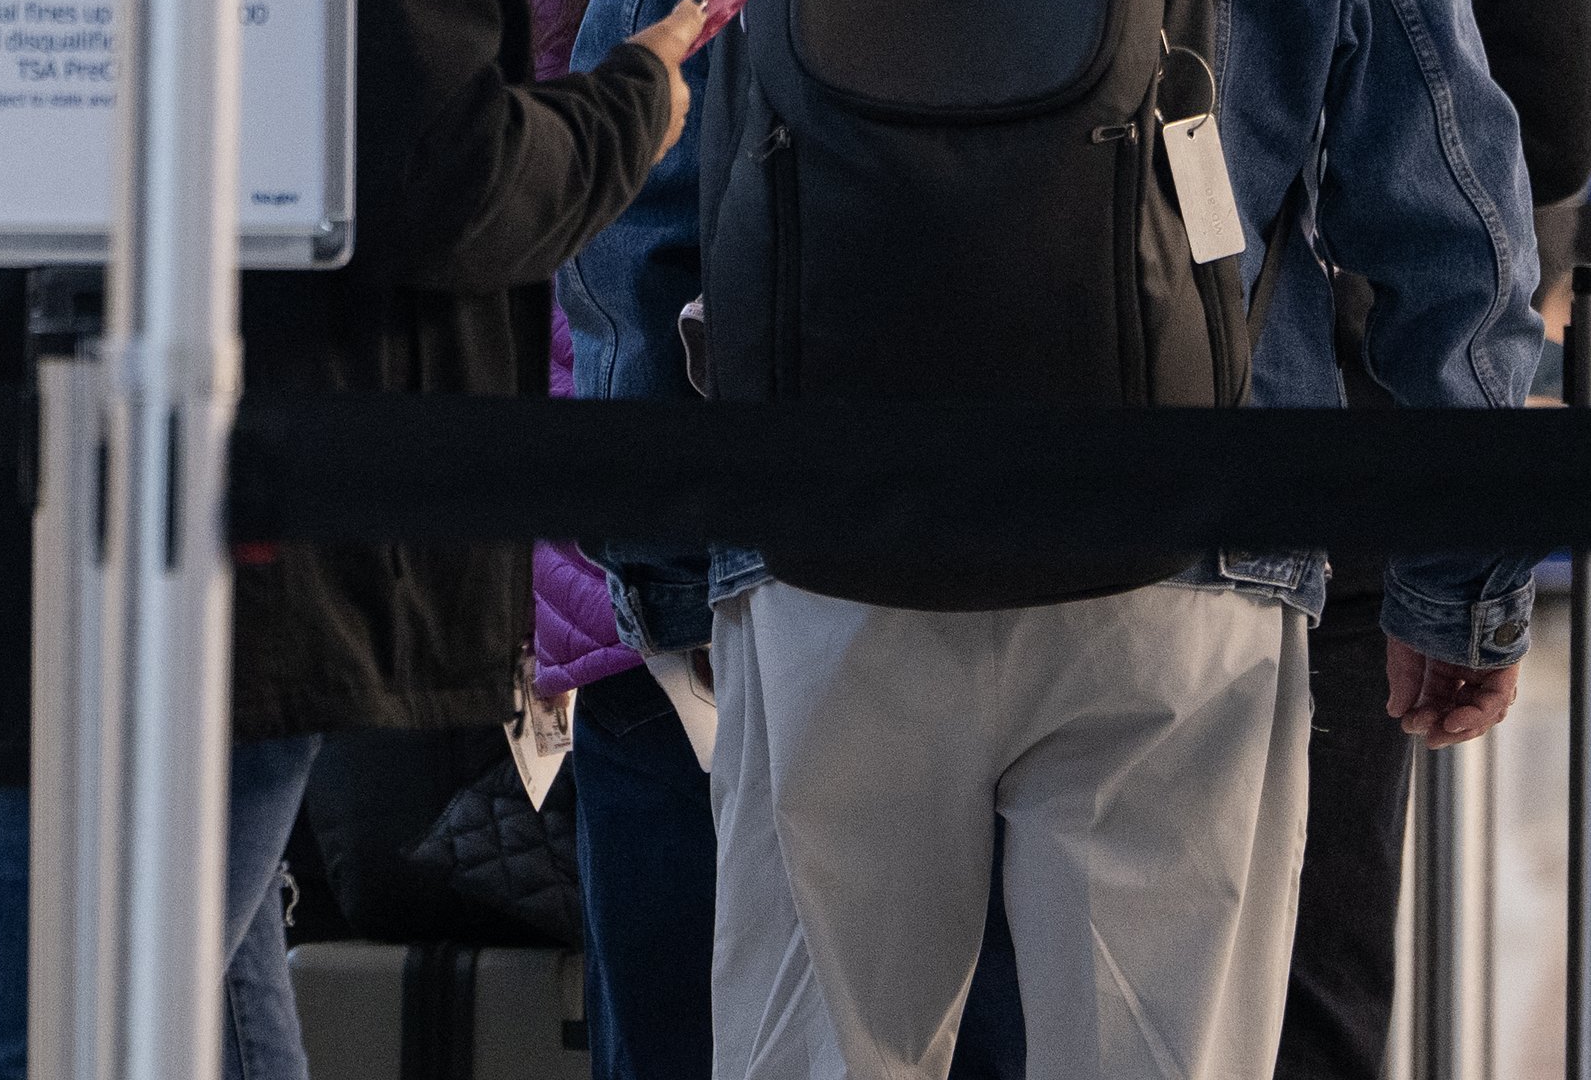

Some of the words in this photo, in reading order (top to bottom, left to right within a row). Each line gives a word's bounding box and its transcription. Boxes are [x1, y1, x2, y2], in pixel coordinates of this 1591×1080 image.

[24, 1, 77, 24] fines
[83, 2, 113, 26] up
[5, 30, 116, 57] disqualific
[17, 59, 58, 81] TSA
[63, 59, 117, 81] PreC
